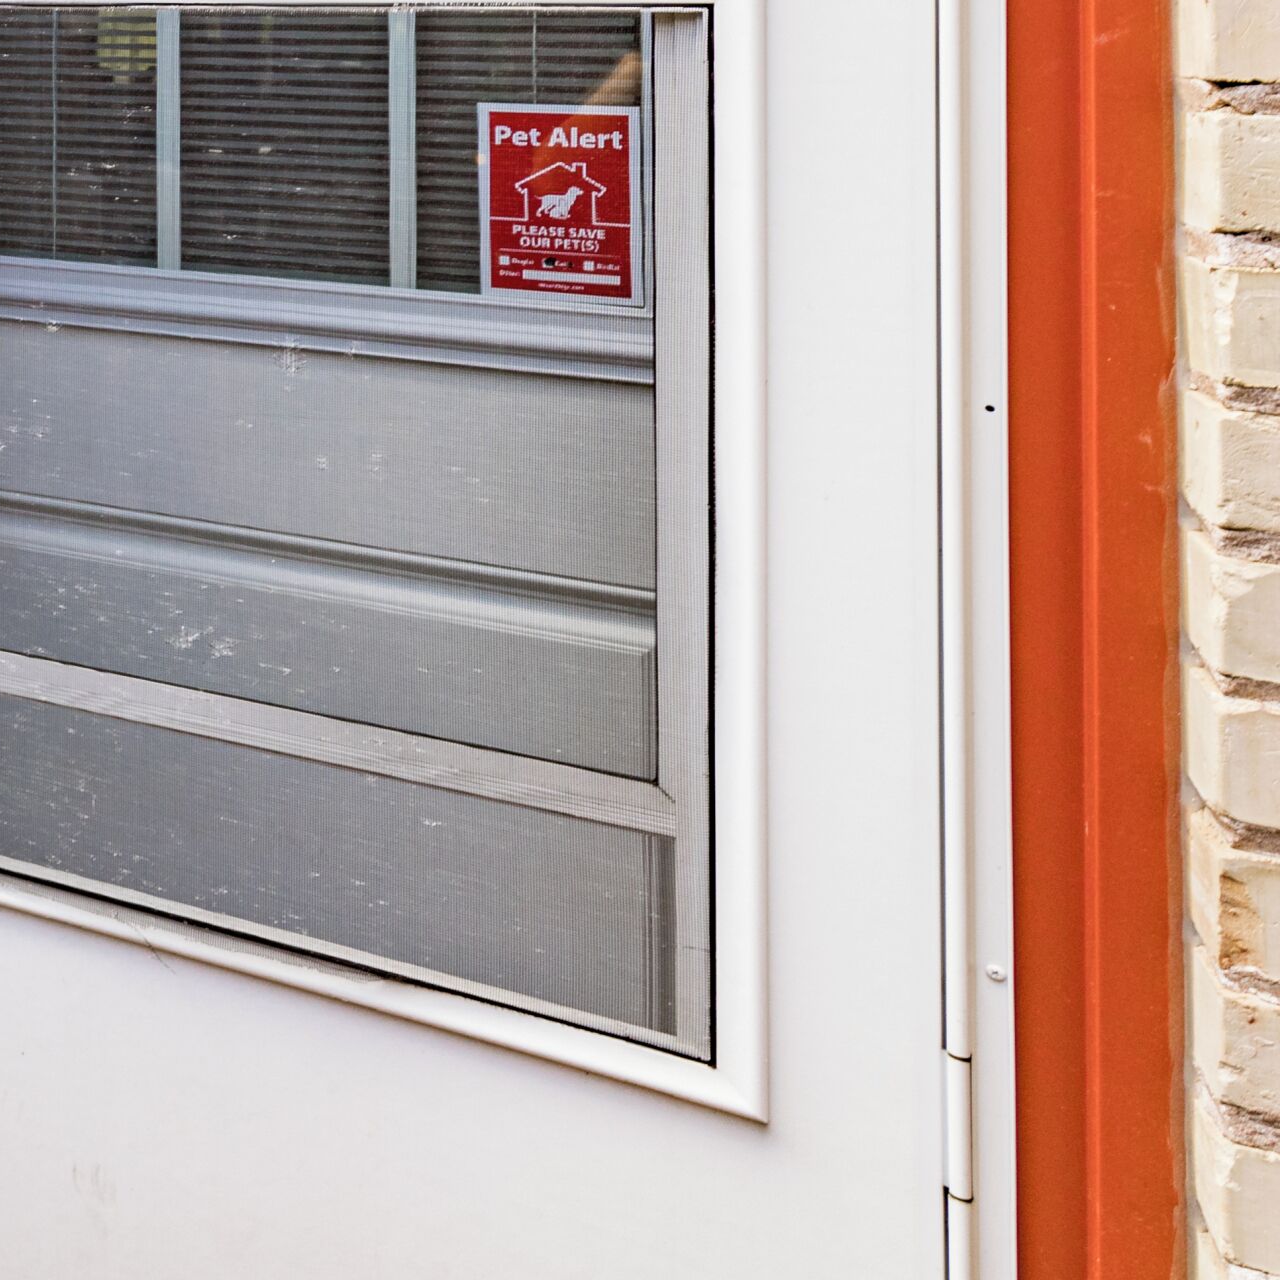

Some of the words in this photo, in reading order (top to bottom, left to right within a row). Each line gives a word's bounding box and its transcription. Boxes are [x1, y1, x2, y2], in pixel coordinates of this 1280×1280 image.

[494, 125, 541, 147] Pet
[548, 126, 623, 150] Alert
[512, 224, 565, 237] PLEASE
[569, 227, 606, 239] SAVE
[520, 236, 550, 248] OUR
[554, 238, 600, 252] PET(S)
